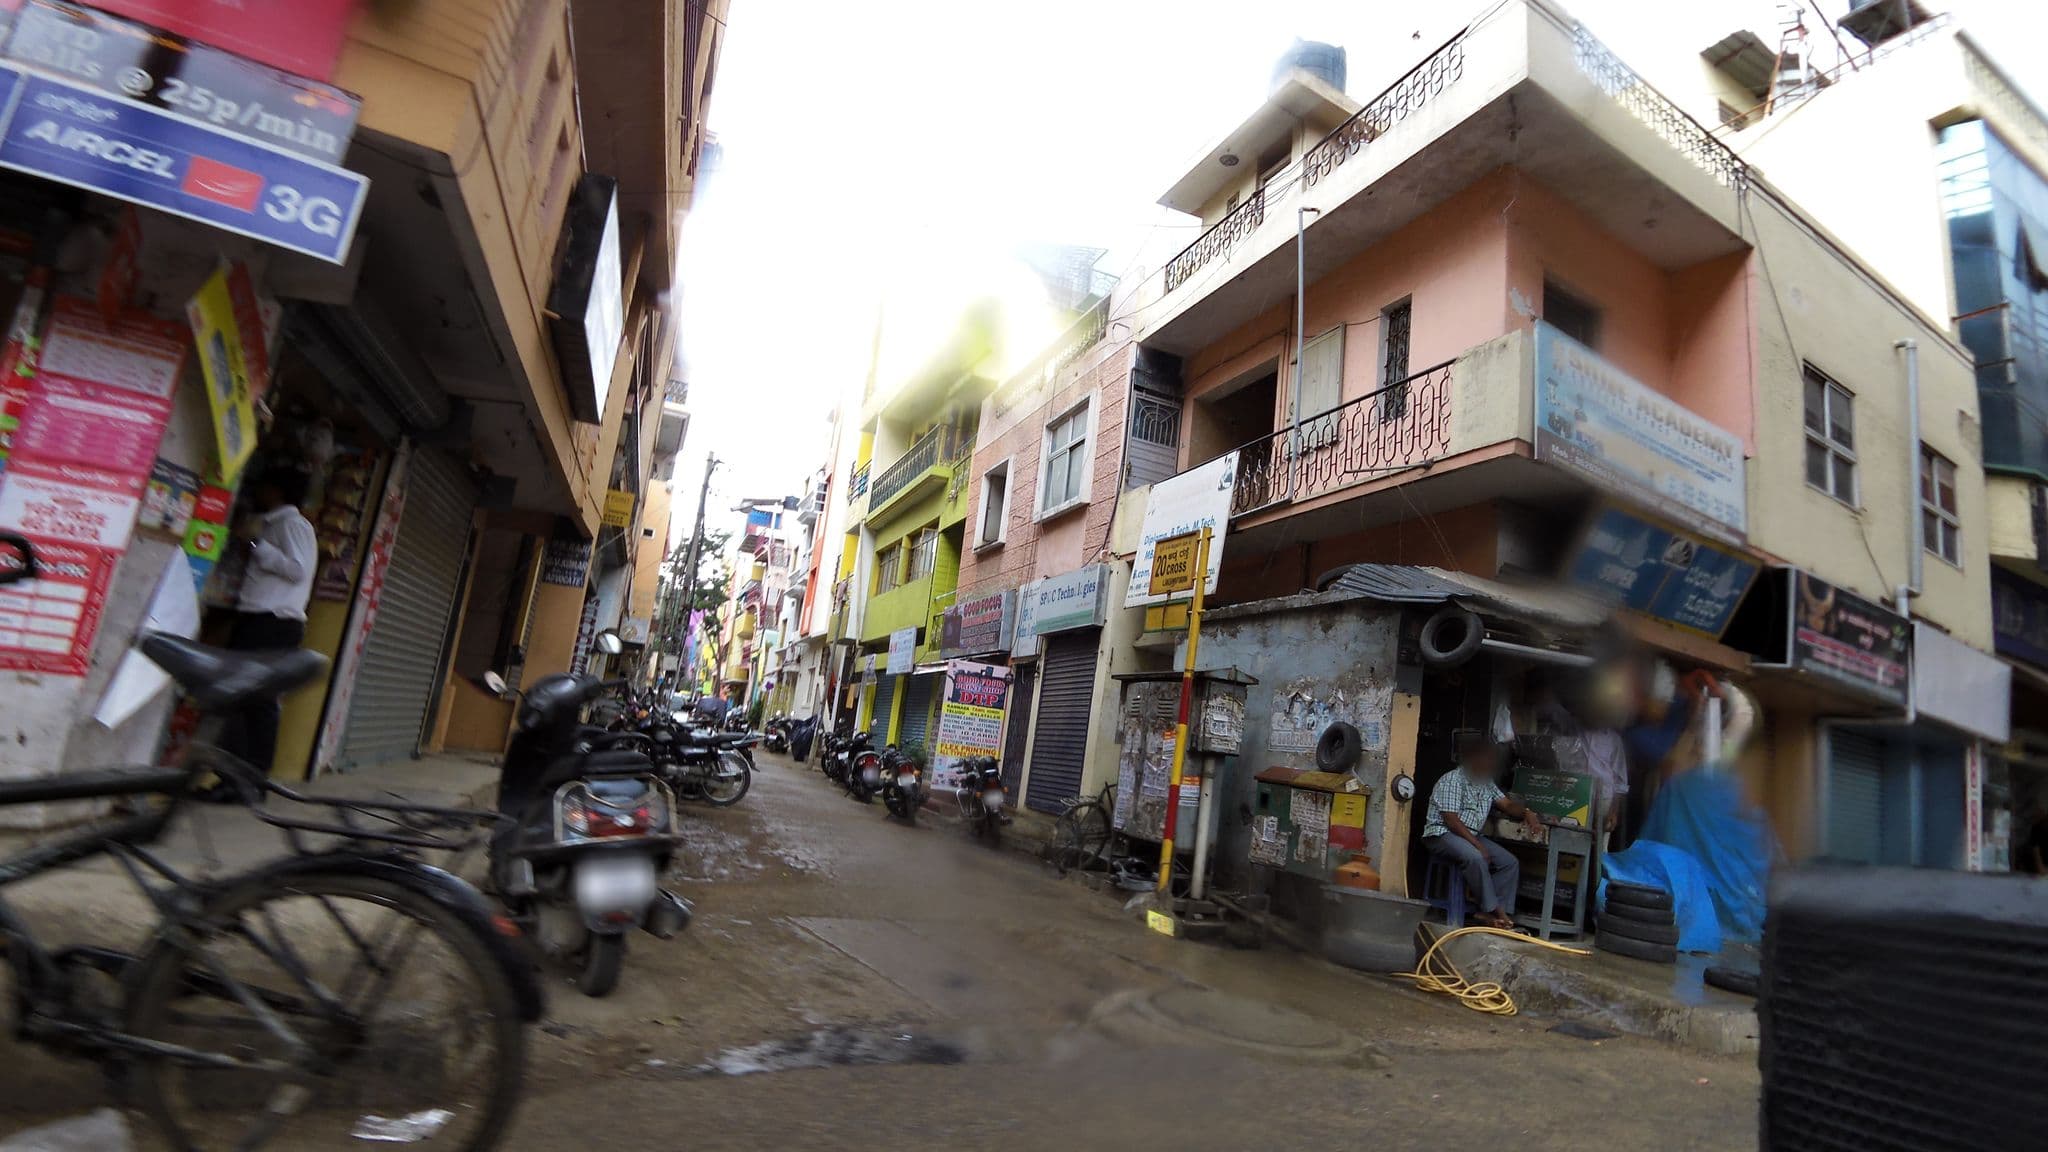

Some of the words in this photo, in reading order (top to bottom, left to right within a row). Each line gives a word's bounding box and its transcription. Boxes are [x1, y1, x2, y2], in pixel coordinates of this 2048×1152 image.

[158, 77, 340, 154] 25p/min
[23, 119, 177, 181] AIRCEL
[263, 184, 344, 239] 3G
[1636, 395, 1735, 459] ACADEMY
[1155, 554, 1168, 578] 20
[1166, 560, 1187, 576] CROSS
[963, 600, 981, 617] GOOD
[980, 593, 1003, 613] FOCUS
[956, 674, 980, 684] GOOD
[959, 690, 999, 707] DTP
[961, 746, 998, 757] PRINTING
